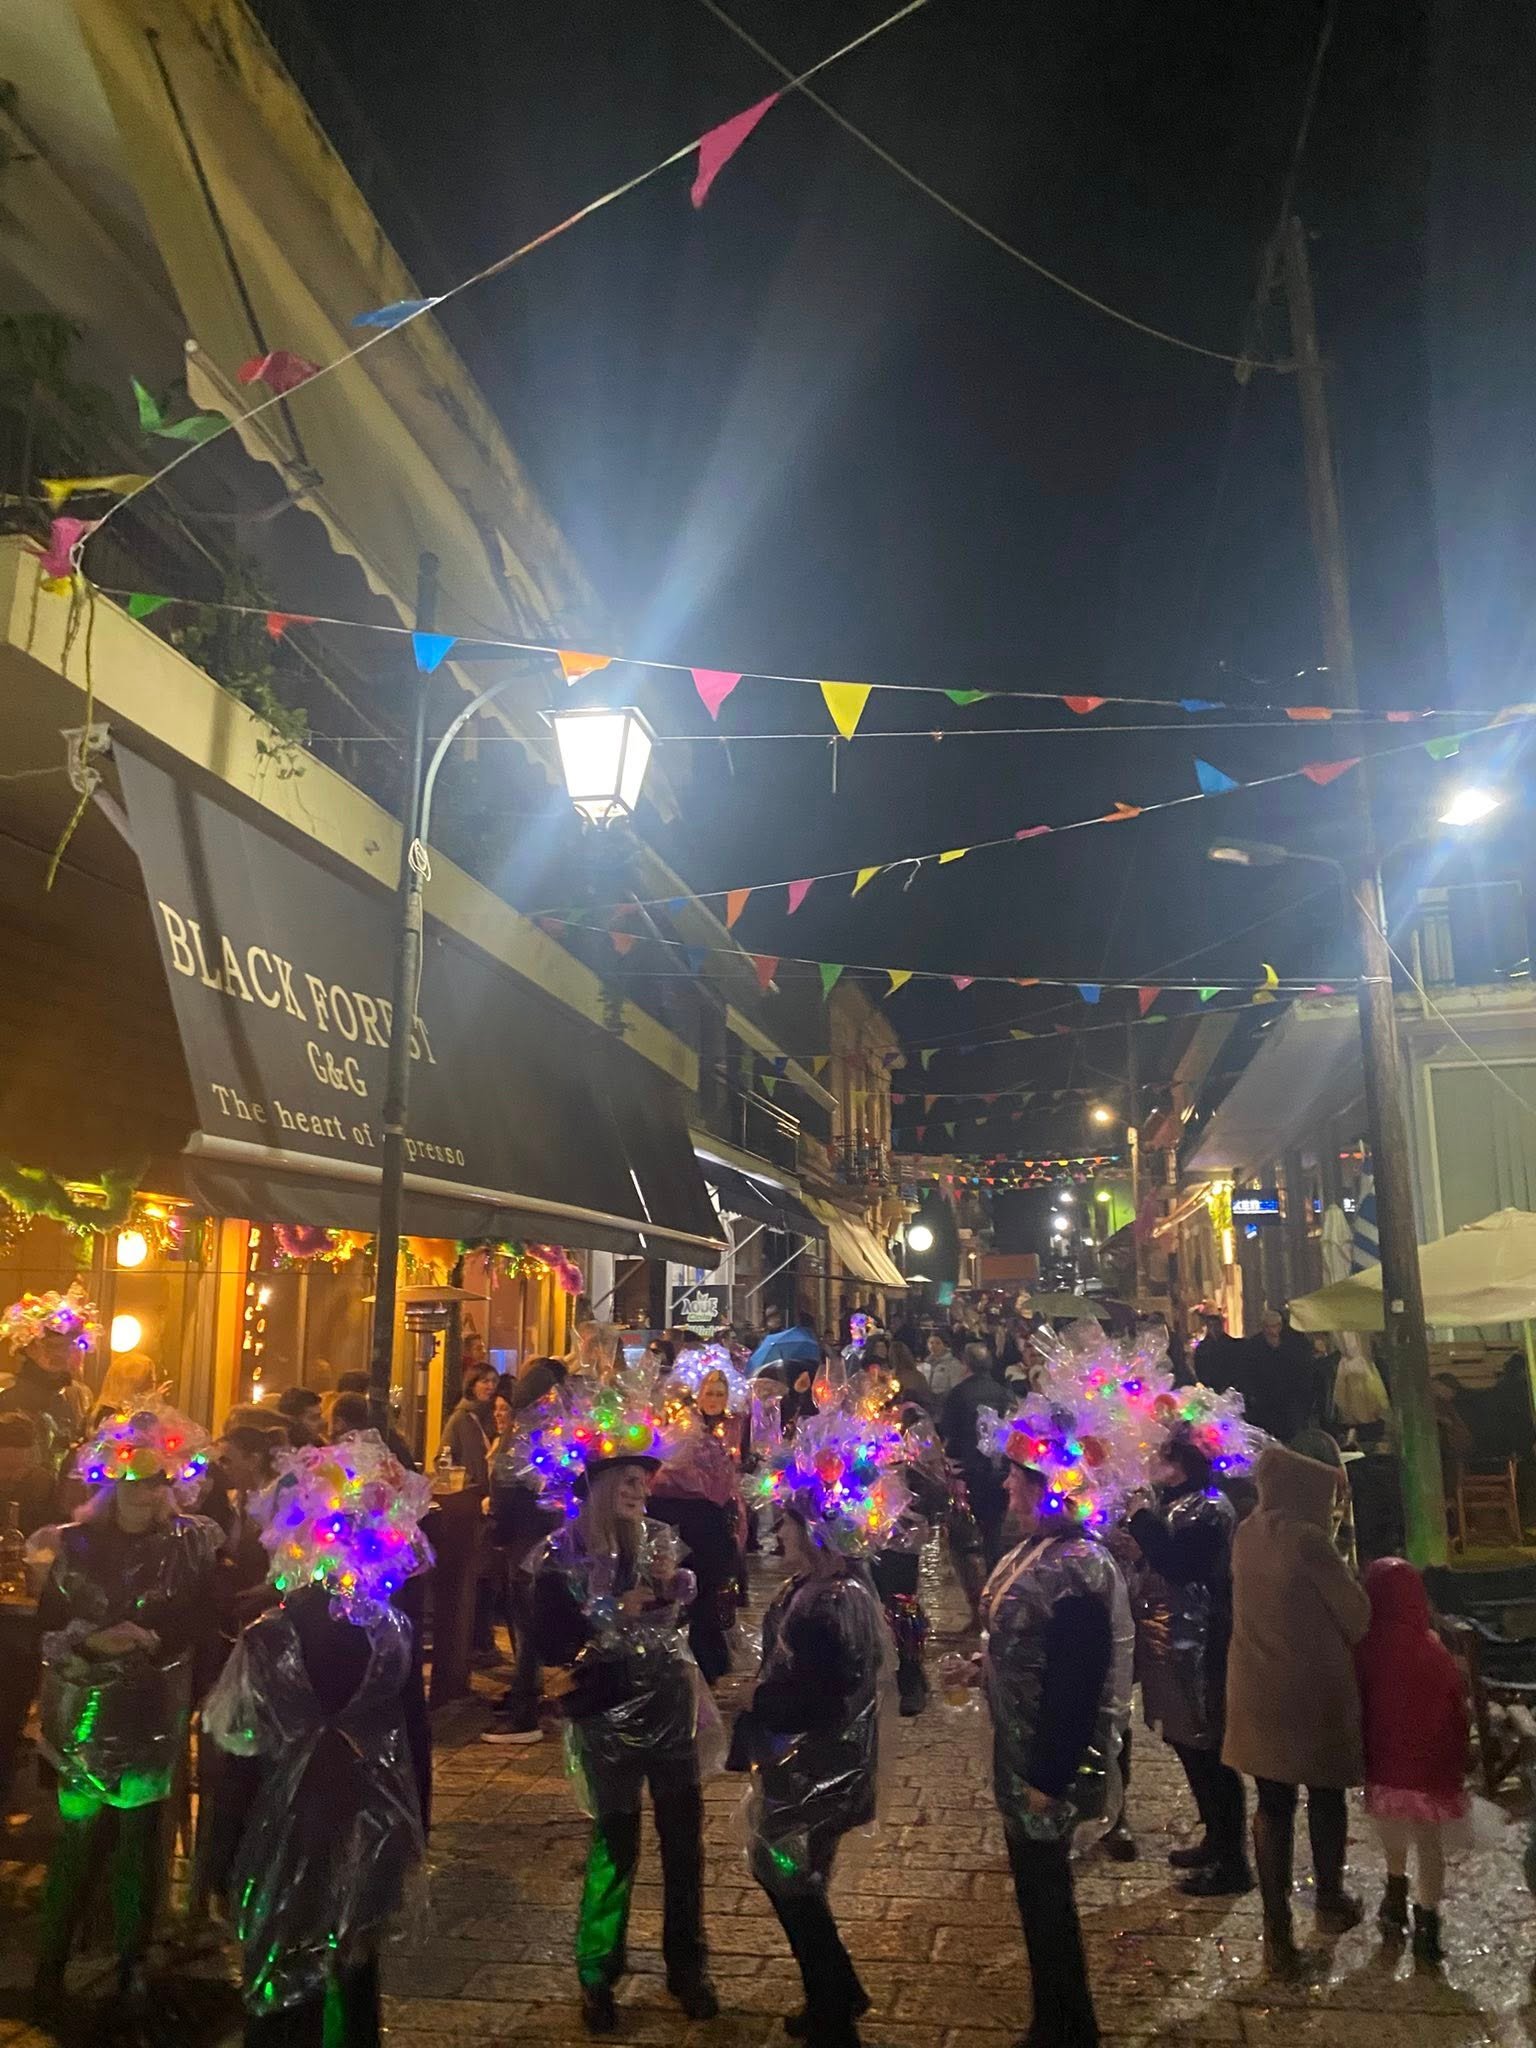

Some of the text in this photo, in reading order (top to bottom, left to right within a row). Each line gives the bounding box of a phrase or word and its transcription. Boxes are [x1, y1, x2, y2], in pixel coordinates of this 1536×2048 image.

[158, 900, 307, 1022] BLACK
[307, 1041, 368, 1098] G&G
[212, 1083, 465, 1167] The heart of presso
